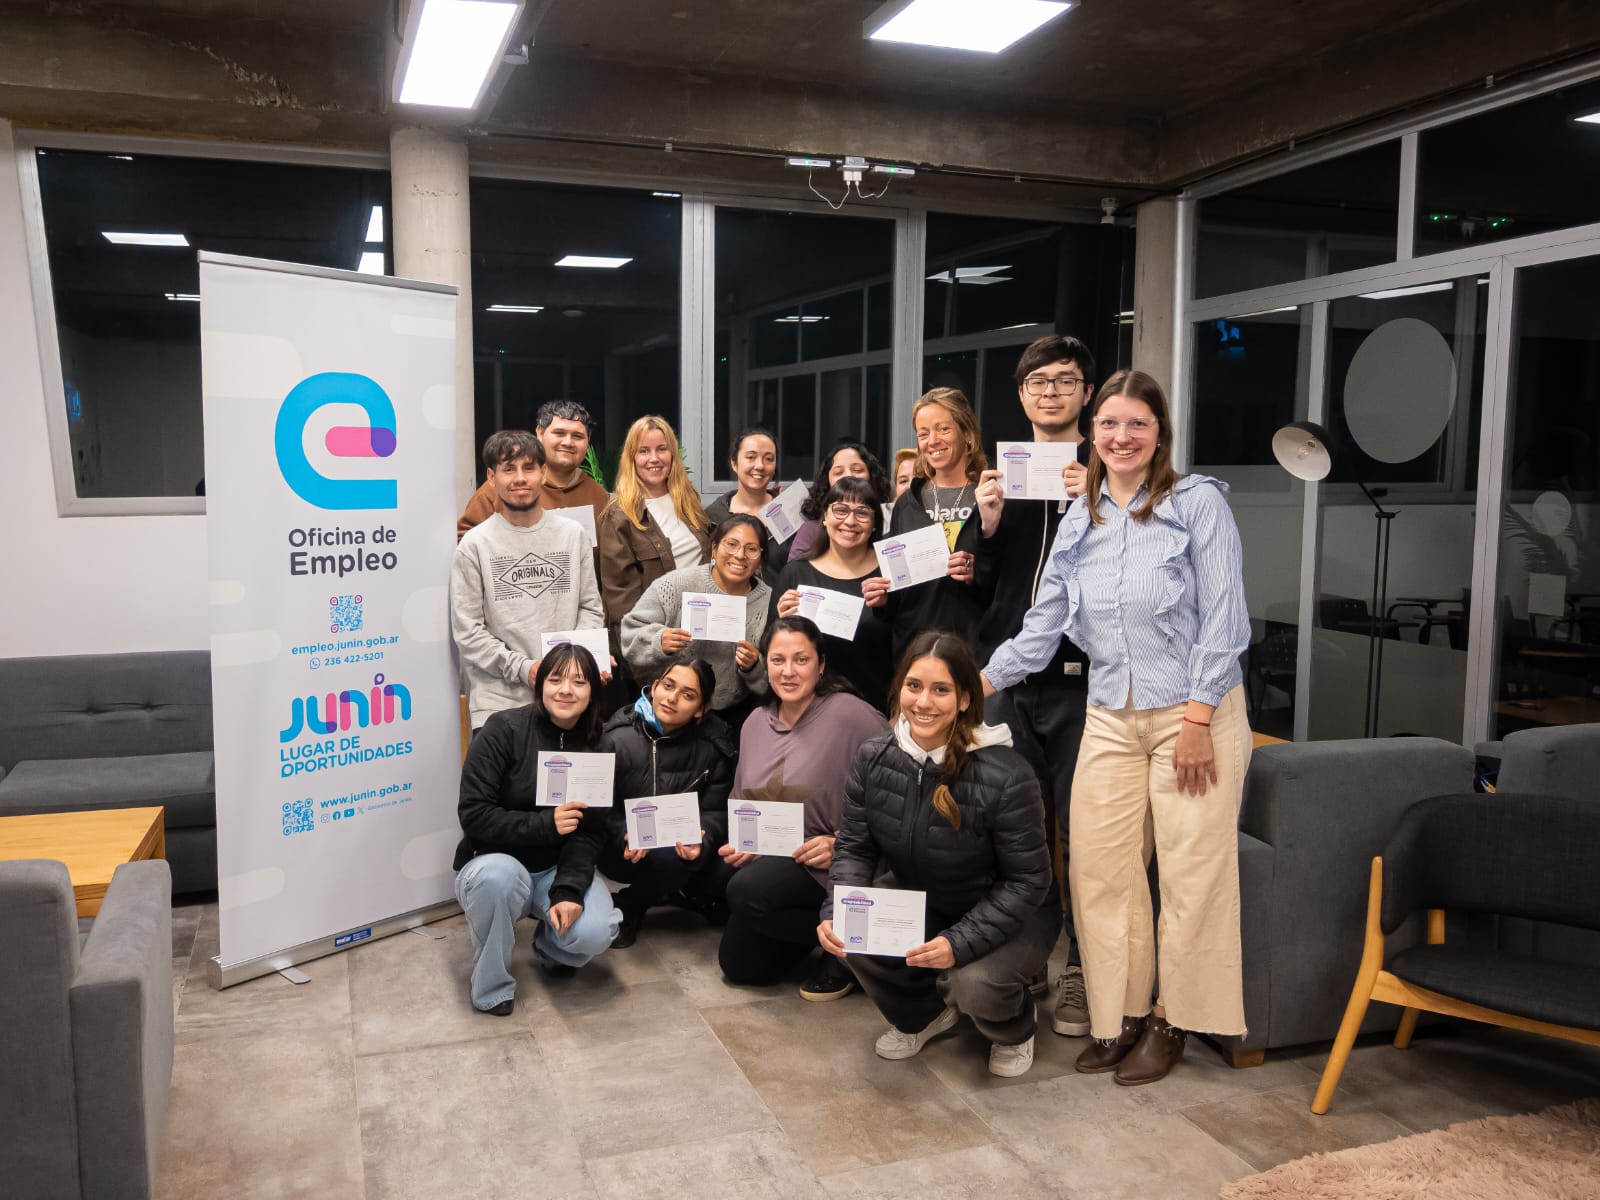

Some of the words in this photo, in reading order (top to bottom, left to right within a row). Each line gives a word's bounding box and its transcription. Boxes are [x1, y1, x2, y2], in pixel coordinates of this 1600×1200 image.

[288, 527, 366, 547] Oficina
[371, 525, 397, 544] de
[290, 548, 398, 578] Empleo
[511, 566, 556, 583] ORIGINALS
[291, 634, 399, 656] empleo.junin.gob.ar
[324, 656, 342, 667] 236
[344, 652, 384, 665] 422-5201
[280, 740, 335, 763] LUGAR
[339, 736, 361, 752] DE
[280, 740, 413, 778] OPORTUNIDADES
[319, 781, 413, 810] www.junin.gob.ar
